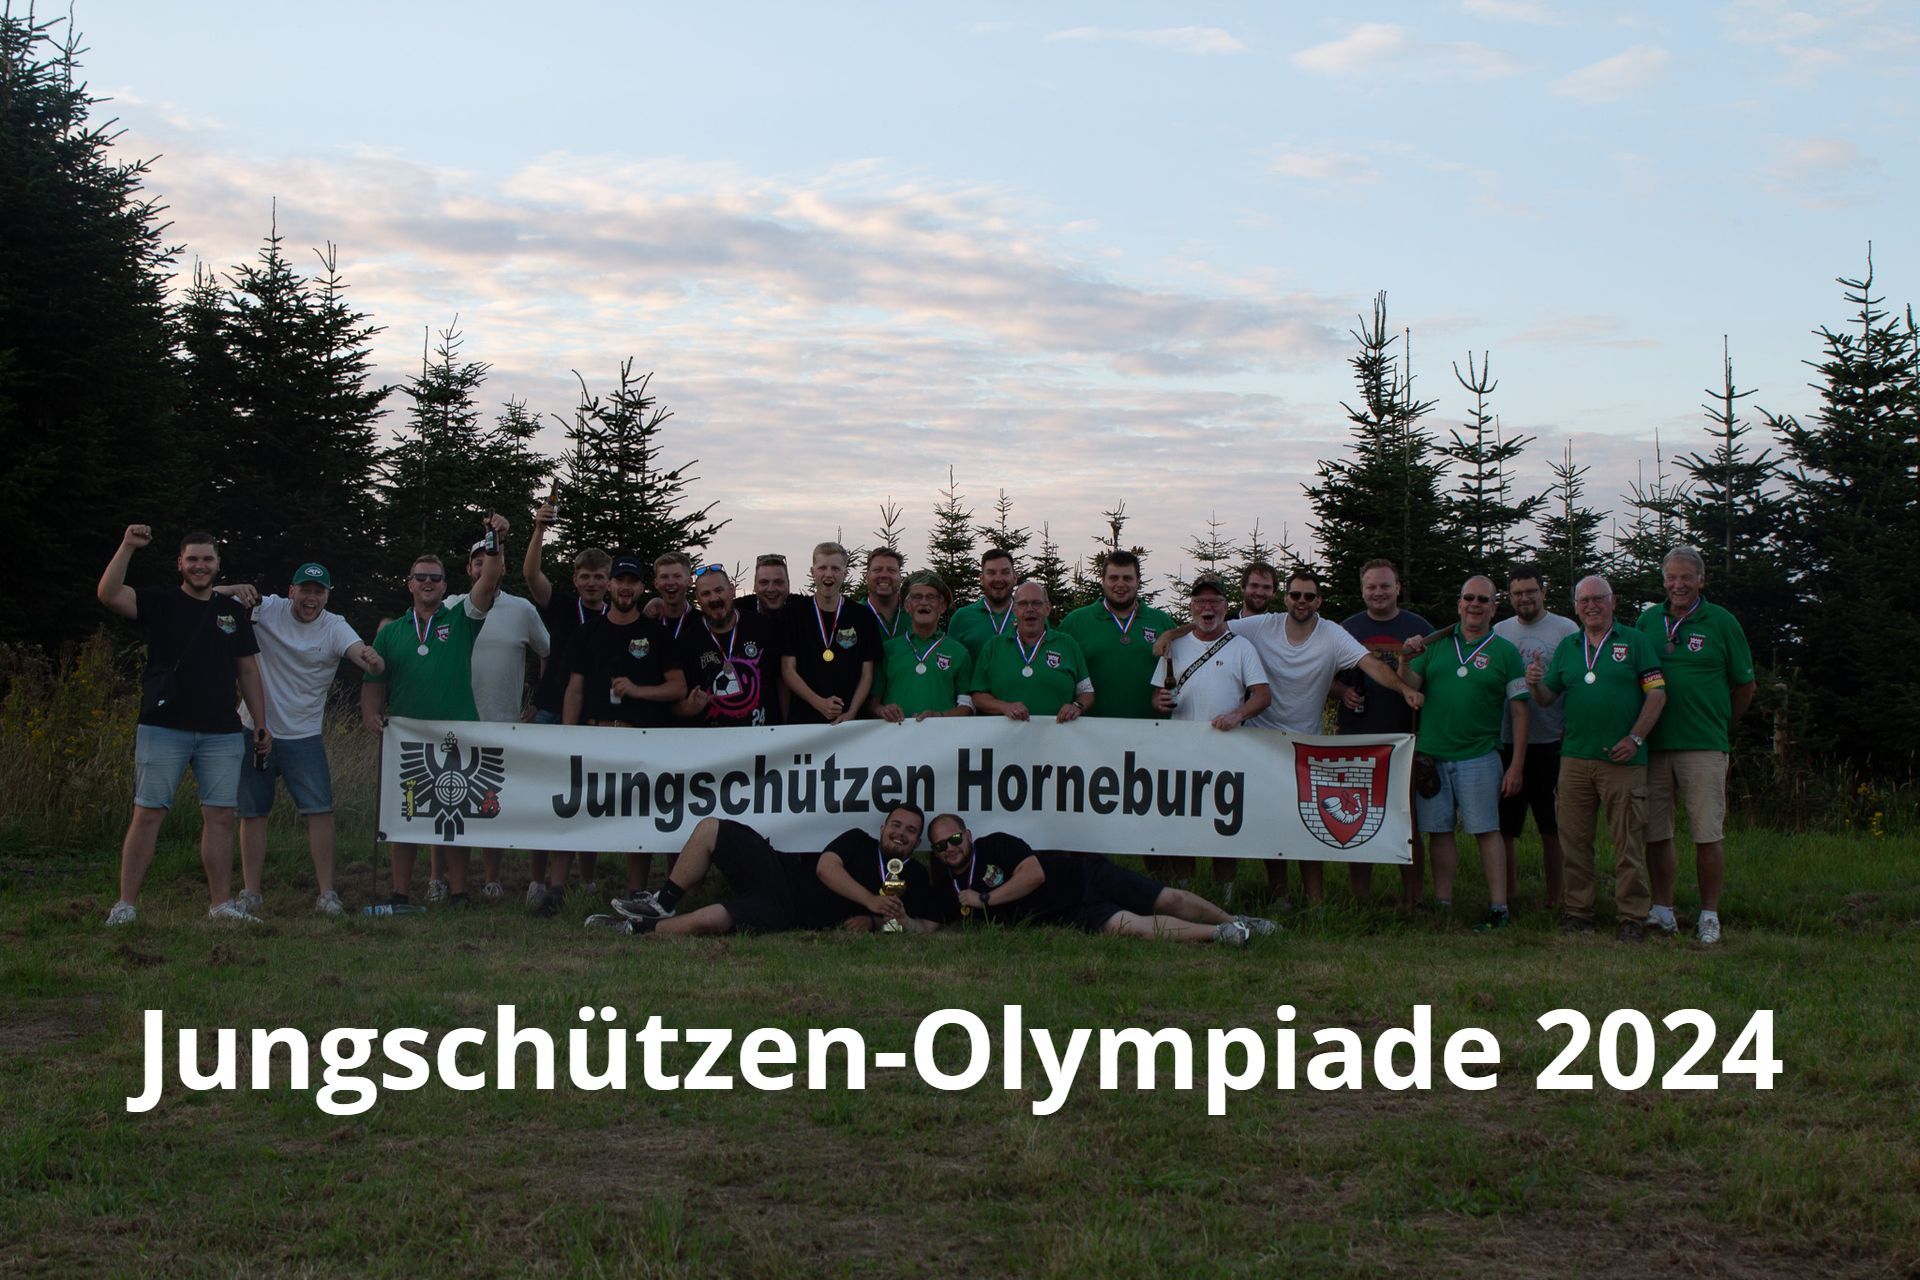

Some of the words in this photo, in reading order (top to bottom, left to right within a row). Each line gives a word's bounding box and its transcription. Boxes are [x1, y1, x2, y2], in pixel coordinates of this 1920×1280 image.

[1209, 637, 1227, 655] adidas
[1185, 659, 1204, 677] adidas
[752, 706, 766, 727] 24
[552, 752, 935, 833] Jungschützen
[957, 748, 1245, 836] Horneburg
